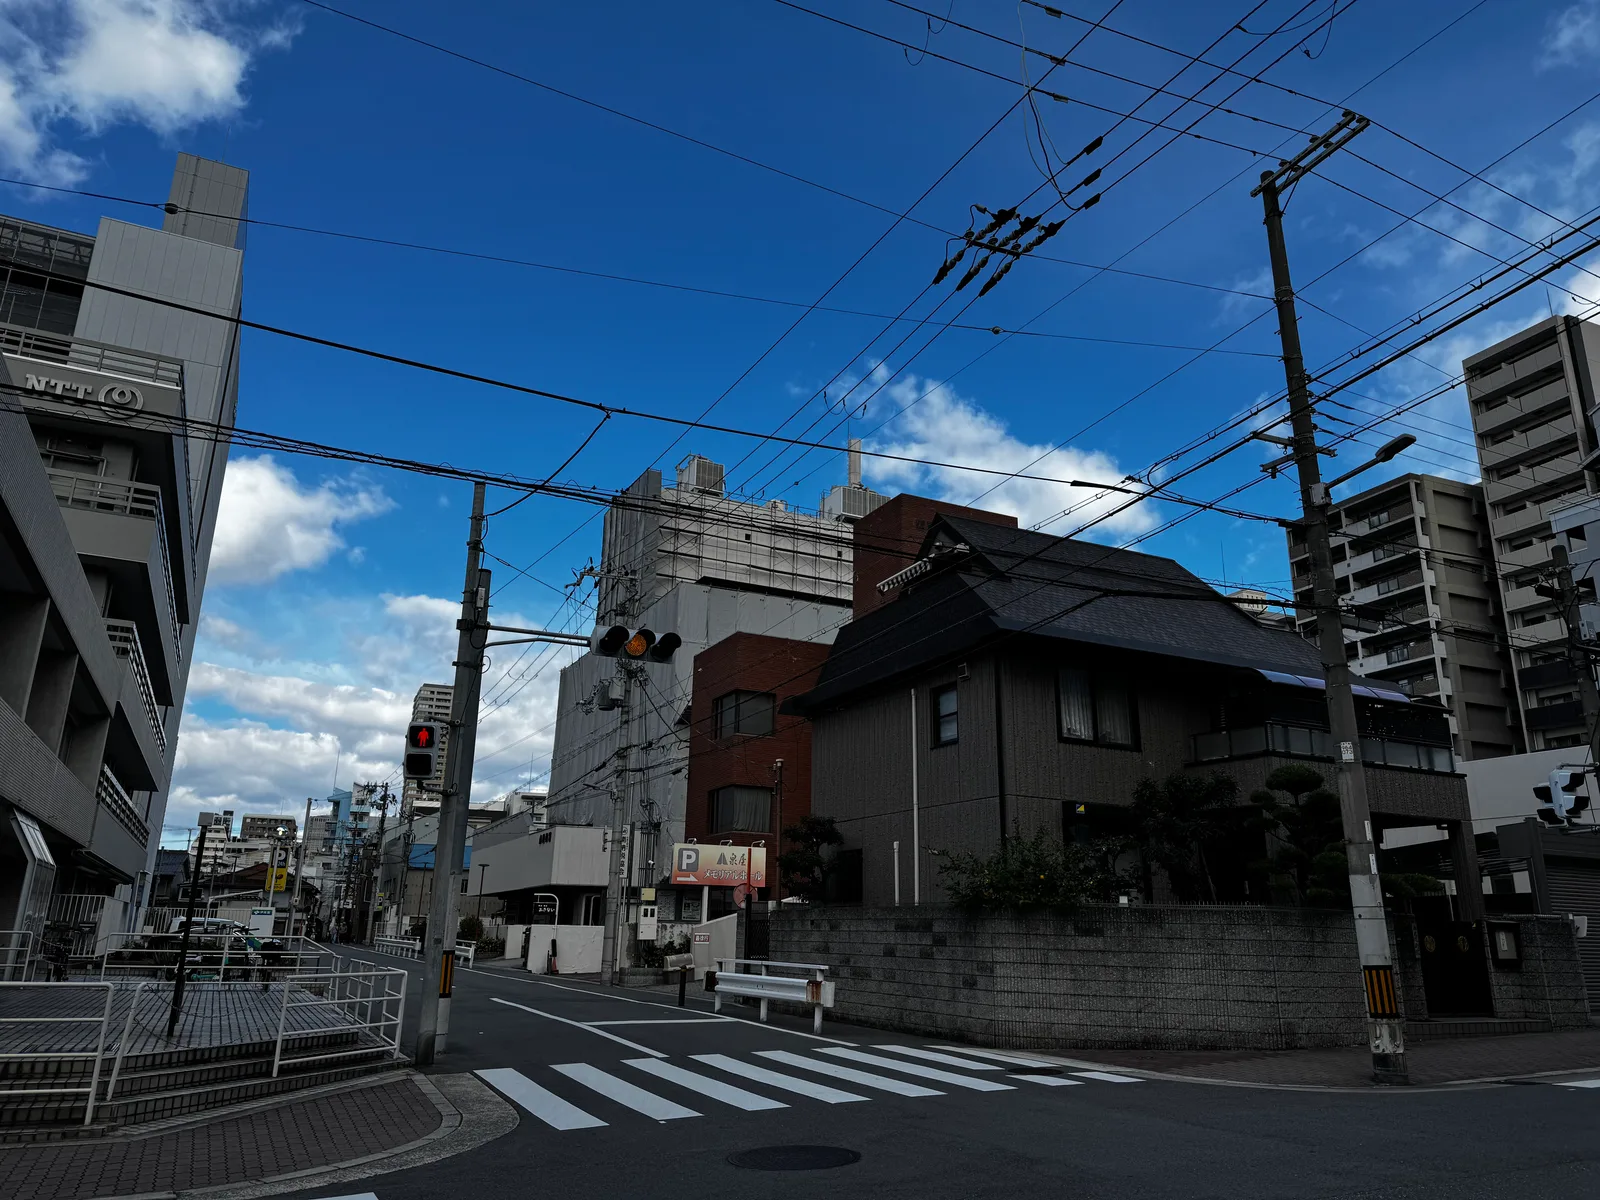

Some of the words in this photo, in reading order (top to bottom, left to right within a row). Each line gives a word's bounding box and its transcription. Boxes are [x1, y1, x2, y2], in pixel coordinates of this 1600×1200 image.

[25, 373, 93, 401] NTT
[681, 850, 697, 870] P
[729, 852, 747, 866] 泉屋
[703, 868, 763, 881] メモリアルホール
